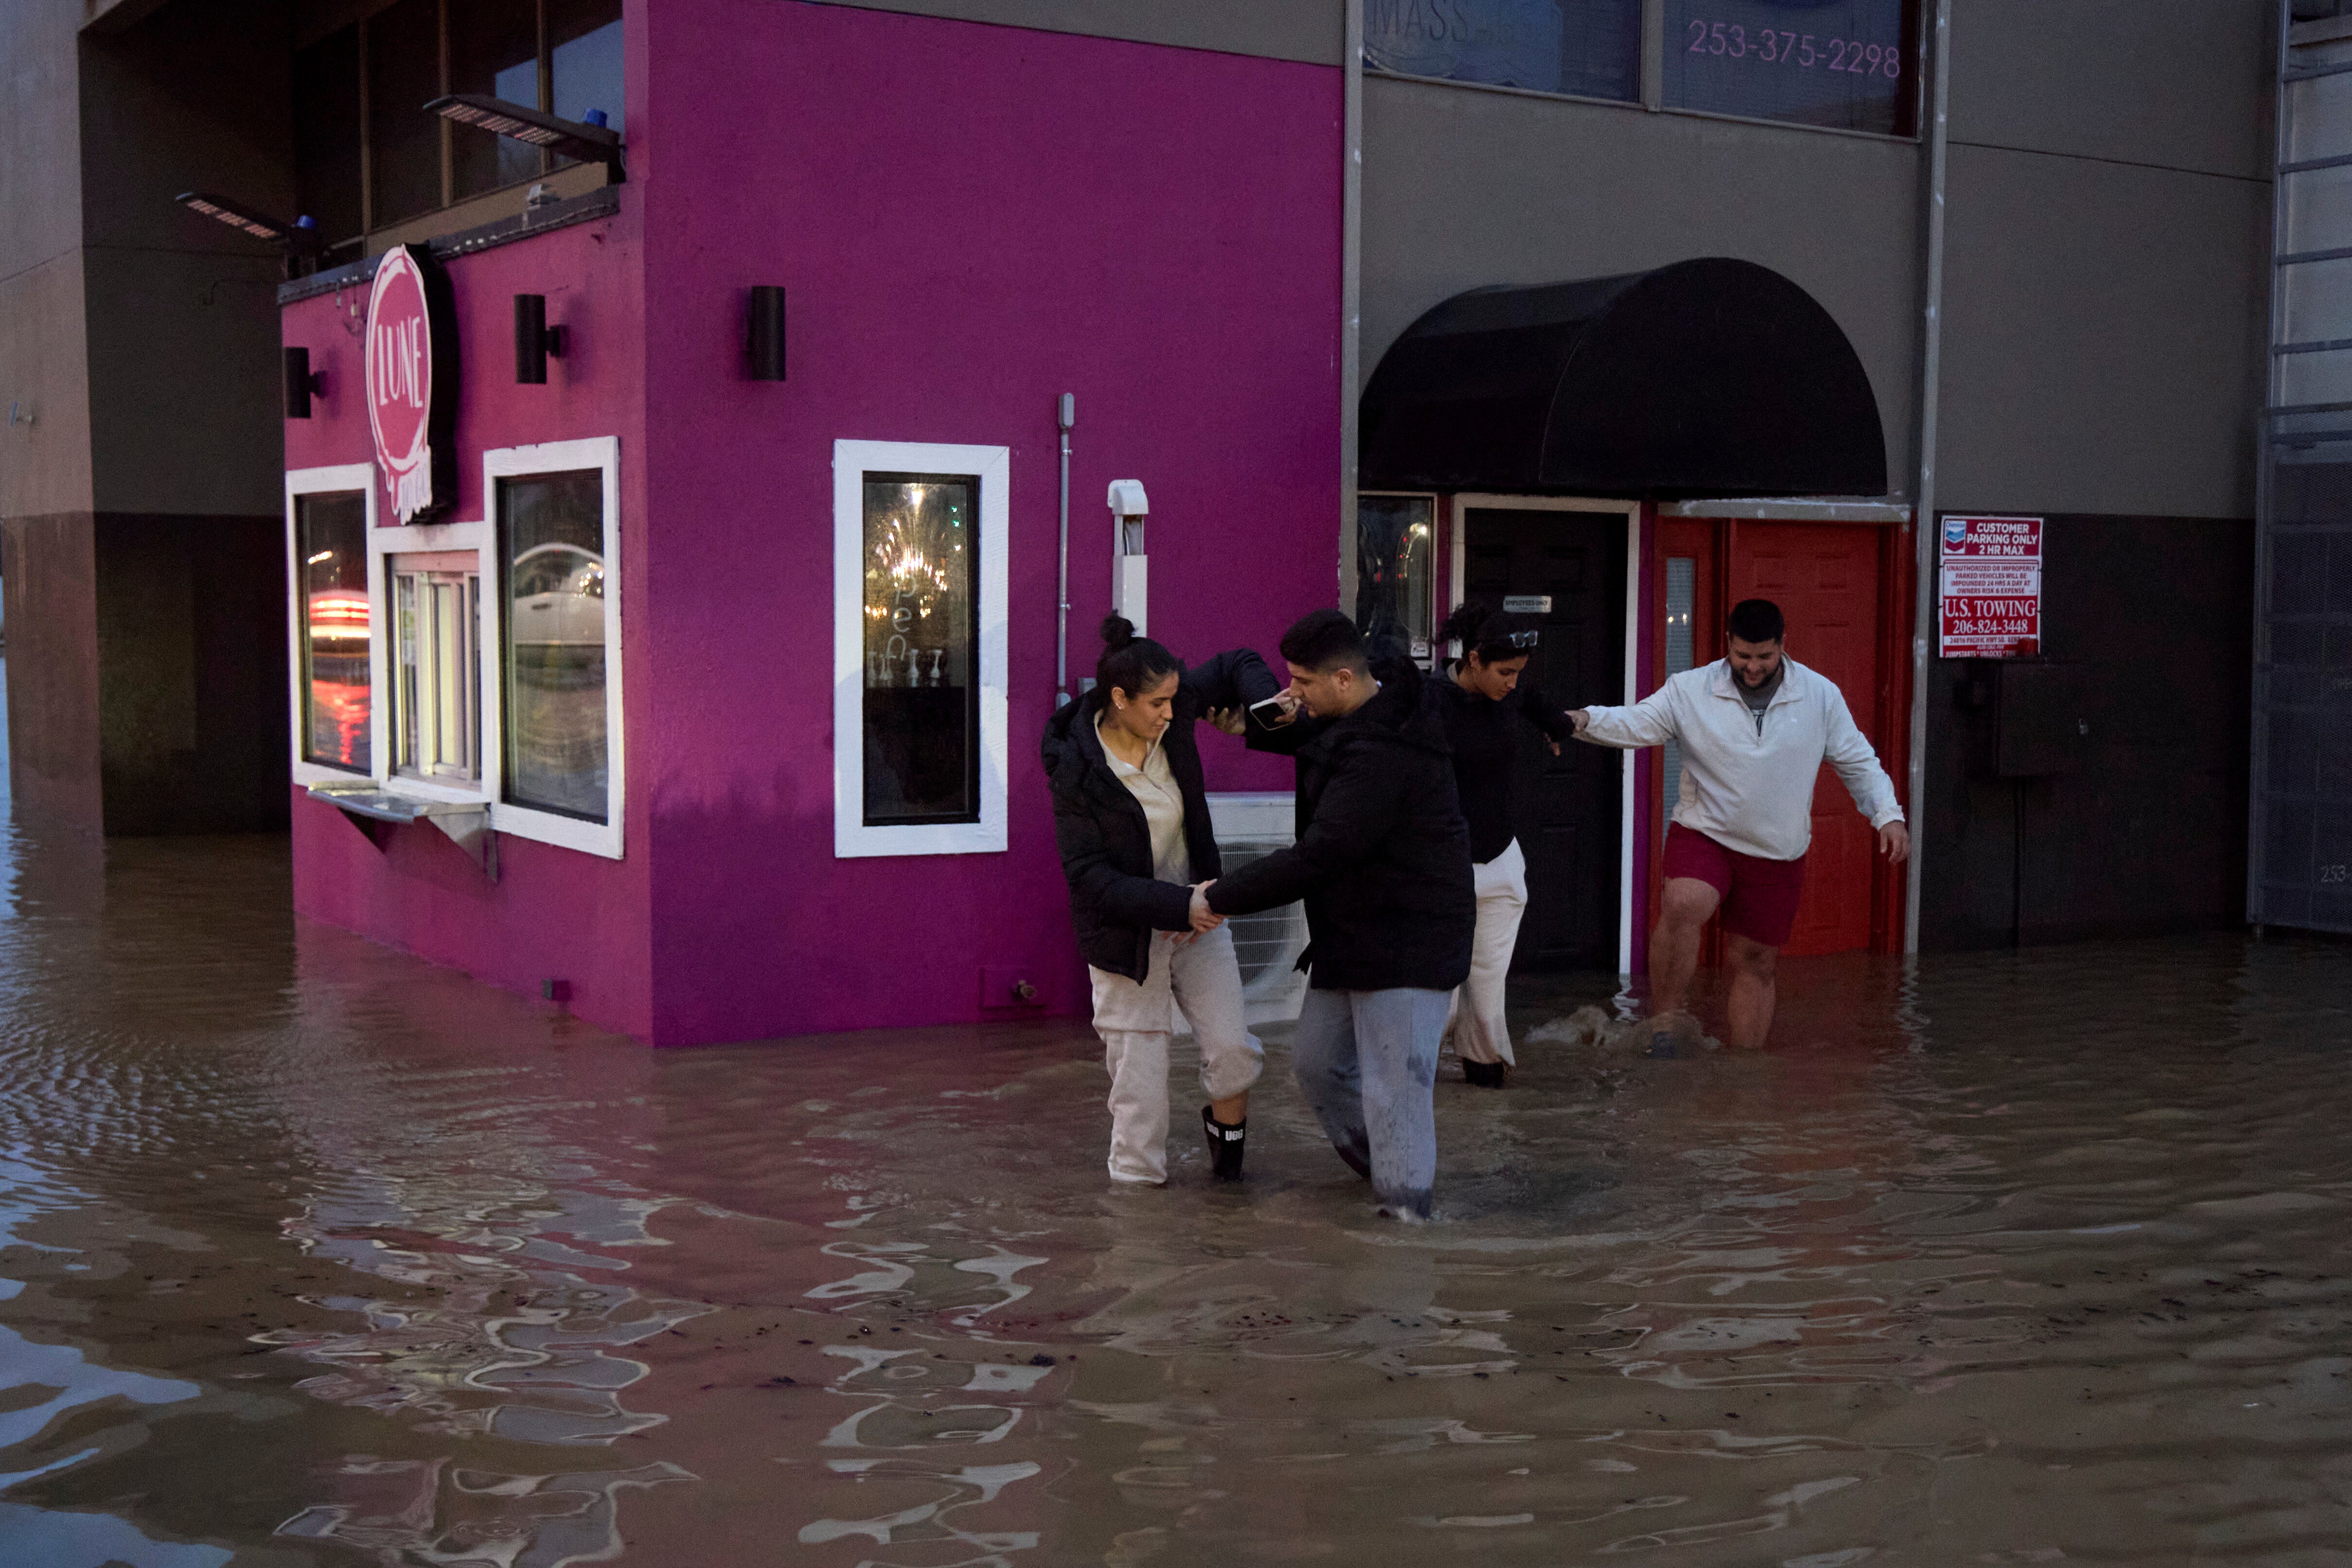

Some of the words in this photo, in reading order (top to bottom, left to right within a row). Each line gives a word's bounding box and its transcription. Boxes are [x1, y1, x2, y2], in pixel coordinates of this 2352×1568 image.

[1689, 19, 1900, 78] 253-375-2298
[377, 315, 423, 408] LUNE
[1976, 522, 2030, 533] CUSTOMER
[1967, 533, 2010, 544] PARKING
[2012, 534, 2037, 544] ONLY
[1979, 545, 1985, 554] 2
[1987, 545, 2001, 555] HR
[2002, 545, 2024, 555] MAX
[1945, 599, 1971, 617] U.S.
[1974, 599, 2036, 617] TOWING
[1953, 619, 2028, 634] 206-824-3448
